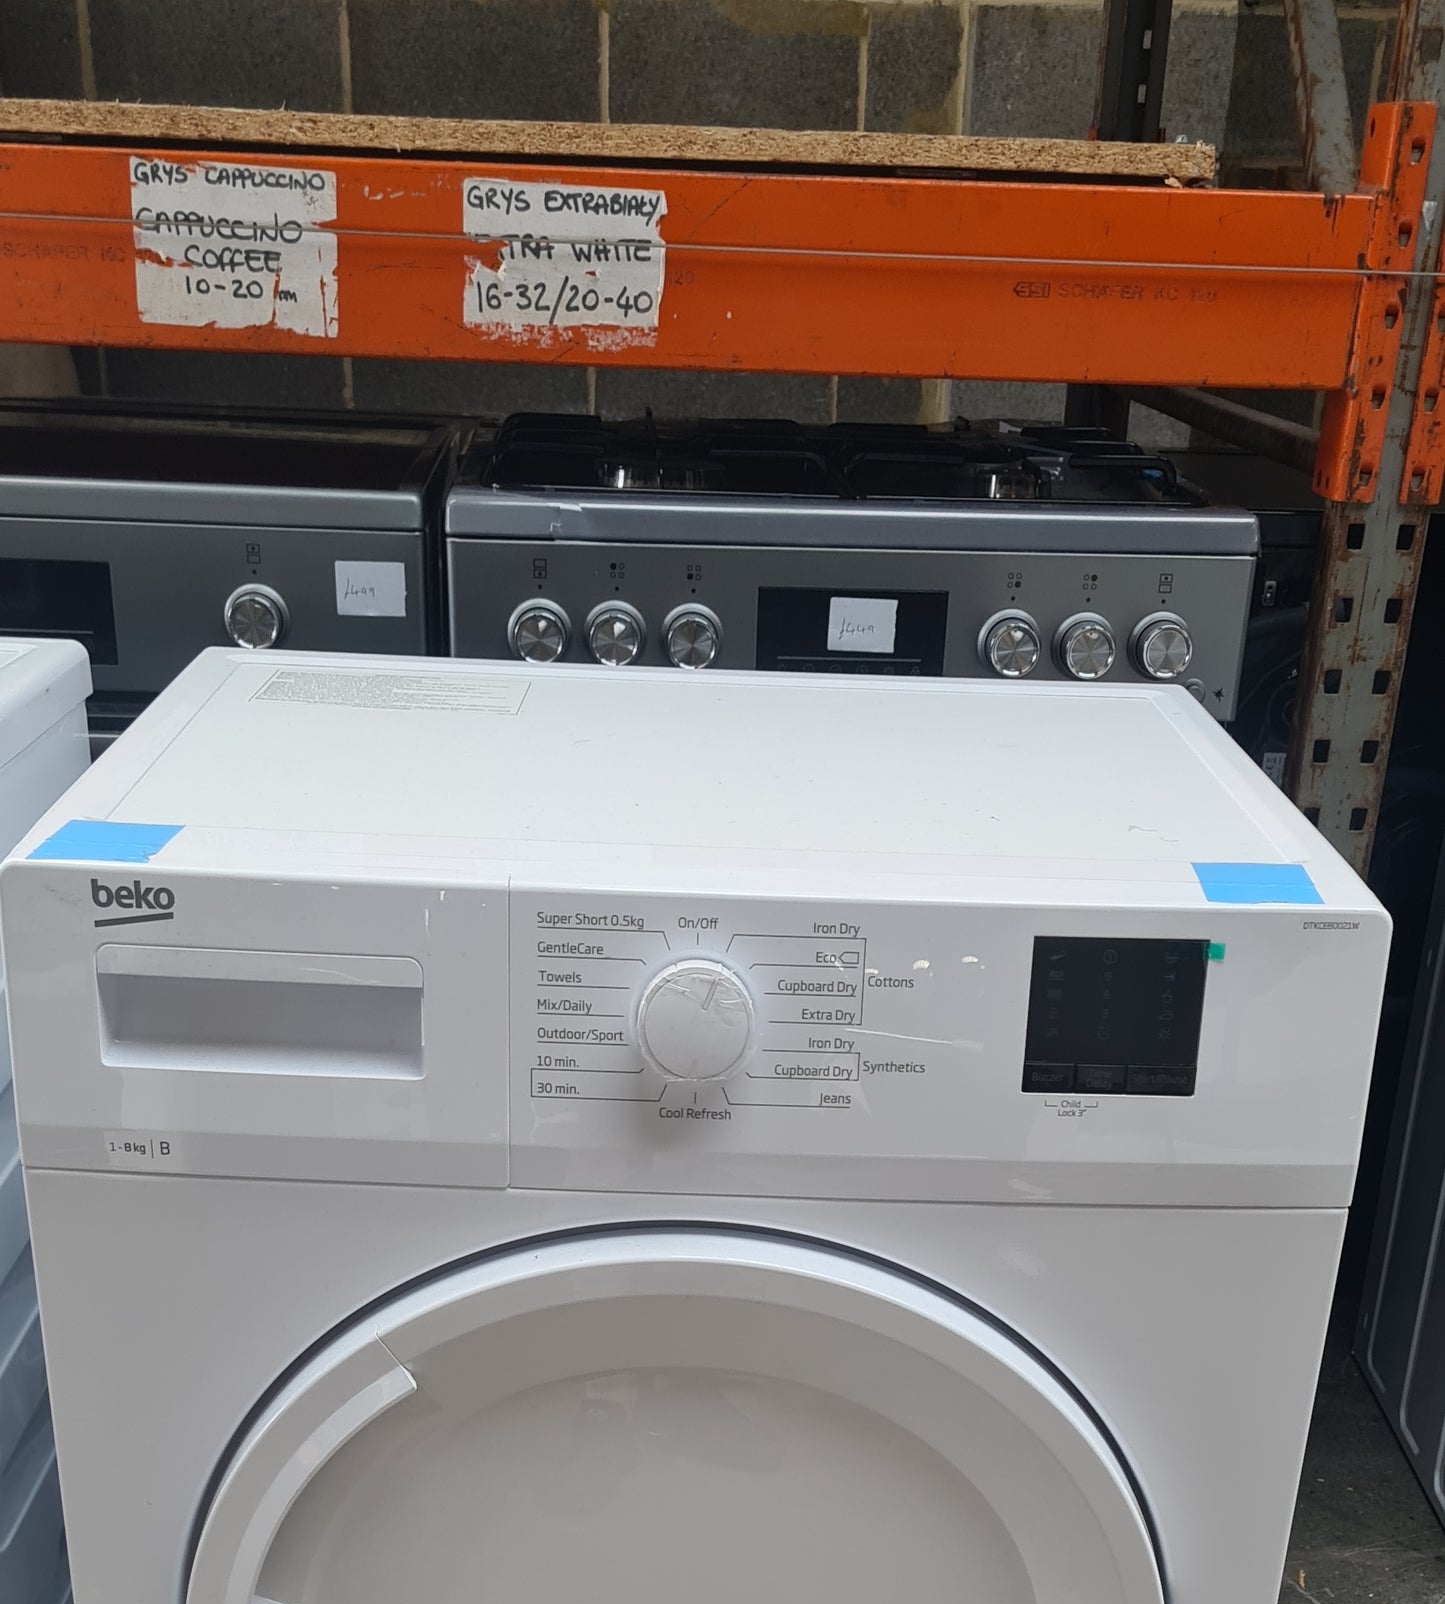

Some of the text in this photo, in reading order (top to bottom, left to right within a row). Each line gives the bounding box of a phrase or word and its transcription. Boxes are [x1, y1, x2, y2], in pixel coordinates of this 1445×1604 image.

[133, 162, 326, 191] GRYS CAPPUCCINO
[467, 184, 531, 216] GRYS
[135, 207, 303, 244] CAPPUCCINO
[183, 244, 283, 273] COFFEE
[185, 275, 264, 299] 10-20
[476, 276, 653, 326] 16-32/20-40
[90, 878, 176, 911] beko
[536, 911, 645, 930] Super Short 0.5kg
[677, 916, 719, 930] On/Off
[812, 922, 861, 938] Iron Dry
[536, 941, 605, 955] GentleCare
[815, 951, 837, 964] Eco
[538, 970, 583, 984] Towels
[867, 975, 915, 989] Cottons
[777, 979, 858, 997] Cupboard Dry
[536, 999, 593, 1016] Mix/Daily
[801, 1008, 856, 1025] Extra Dry
[536, 1027, 625, 1043] Outdoor/Sport
[807, 1037, 856, 1054] Iron Dry
[536, 1055, 581, 1069] 10 min.
[863, 1061, 926, 1075] Synthetics
[773, 1064, 853, 1081] Cupboard Dry
[536, 1082, 581, 1096] 30 min.
[819, 1092, 852, 1106] Jeans
[658, 1107, 732, 1120] Cool Refresh
[159, 1140, 171, 1156] B
